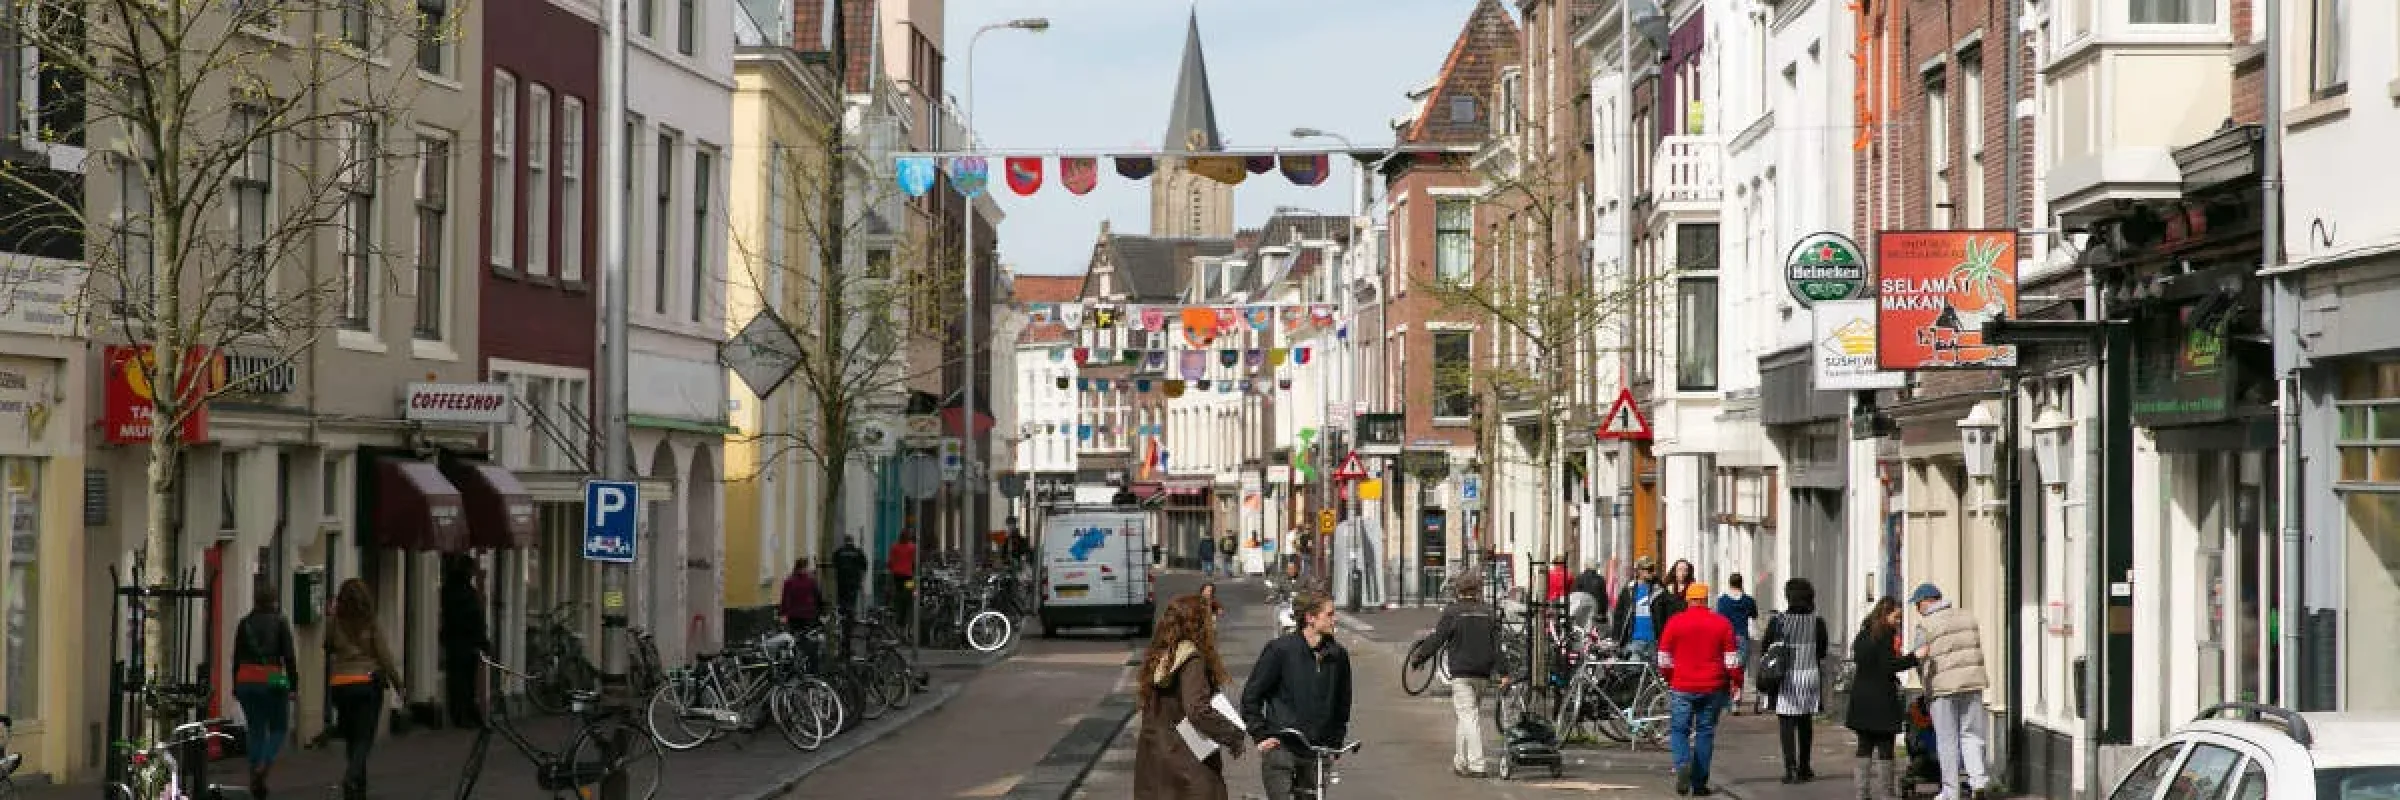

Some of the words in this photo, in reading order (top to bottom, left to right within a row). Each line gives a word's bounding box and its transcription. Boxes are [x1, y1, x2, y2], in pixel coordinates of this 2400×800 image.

[1793, 265, 1859, 279] Heineken
[1881, 277, 1969, 293] SELAMAT
[1881, 294, 1945, 310] MAKAN
[1825, 356, 1861, 367] SUSHI
[411, 391, 504, 411] COFFEESHOP
[595, 487, 627, 528] P
